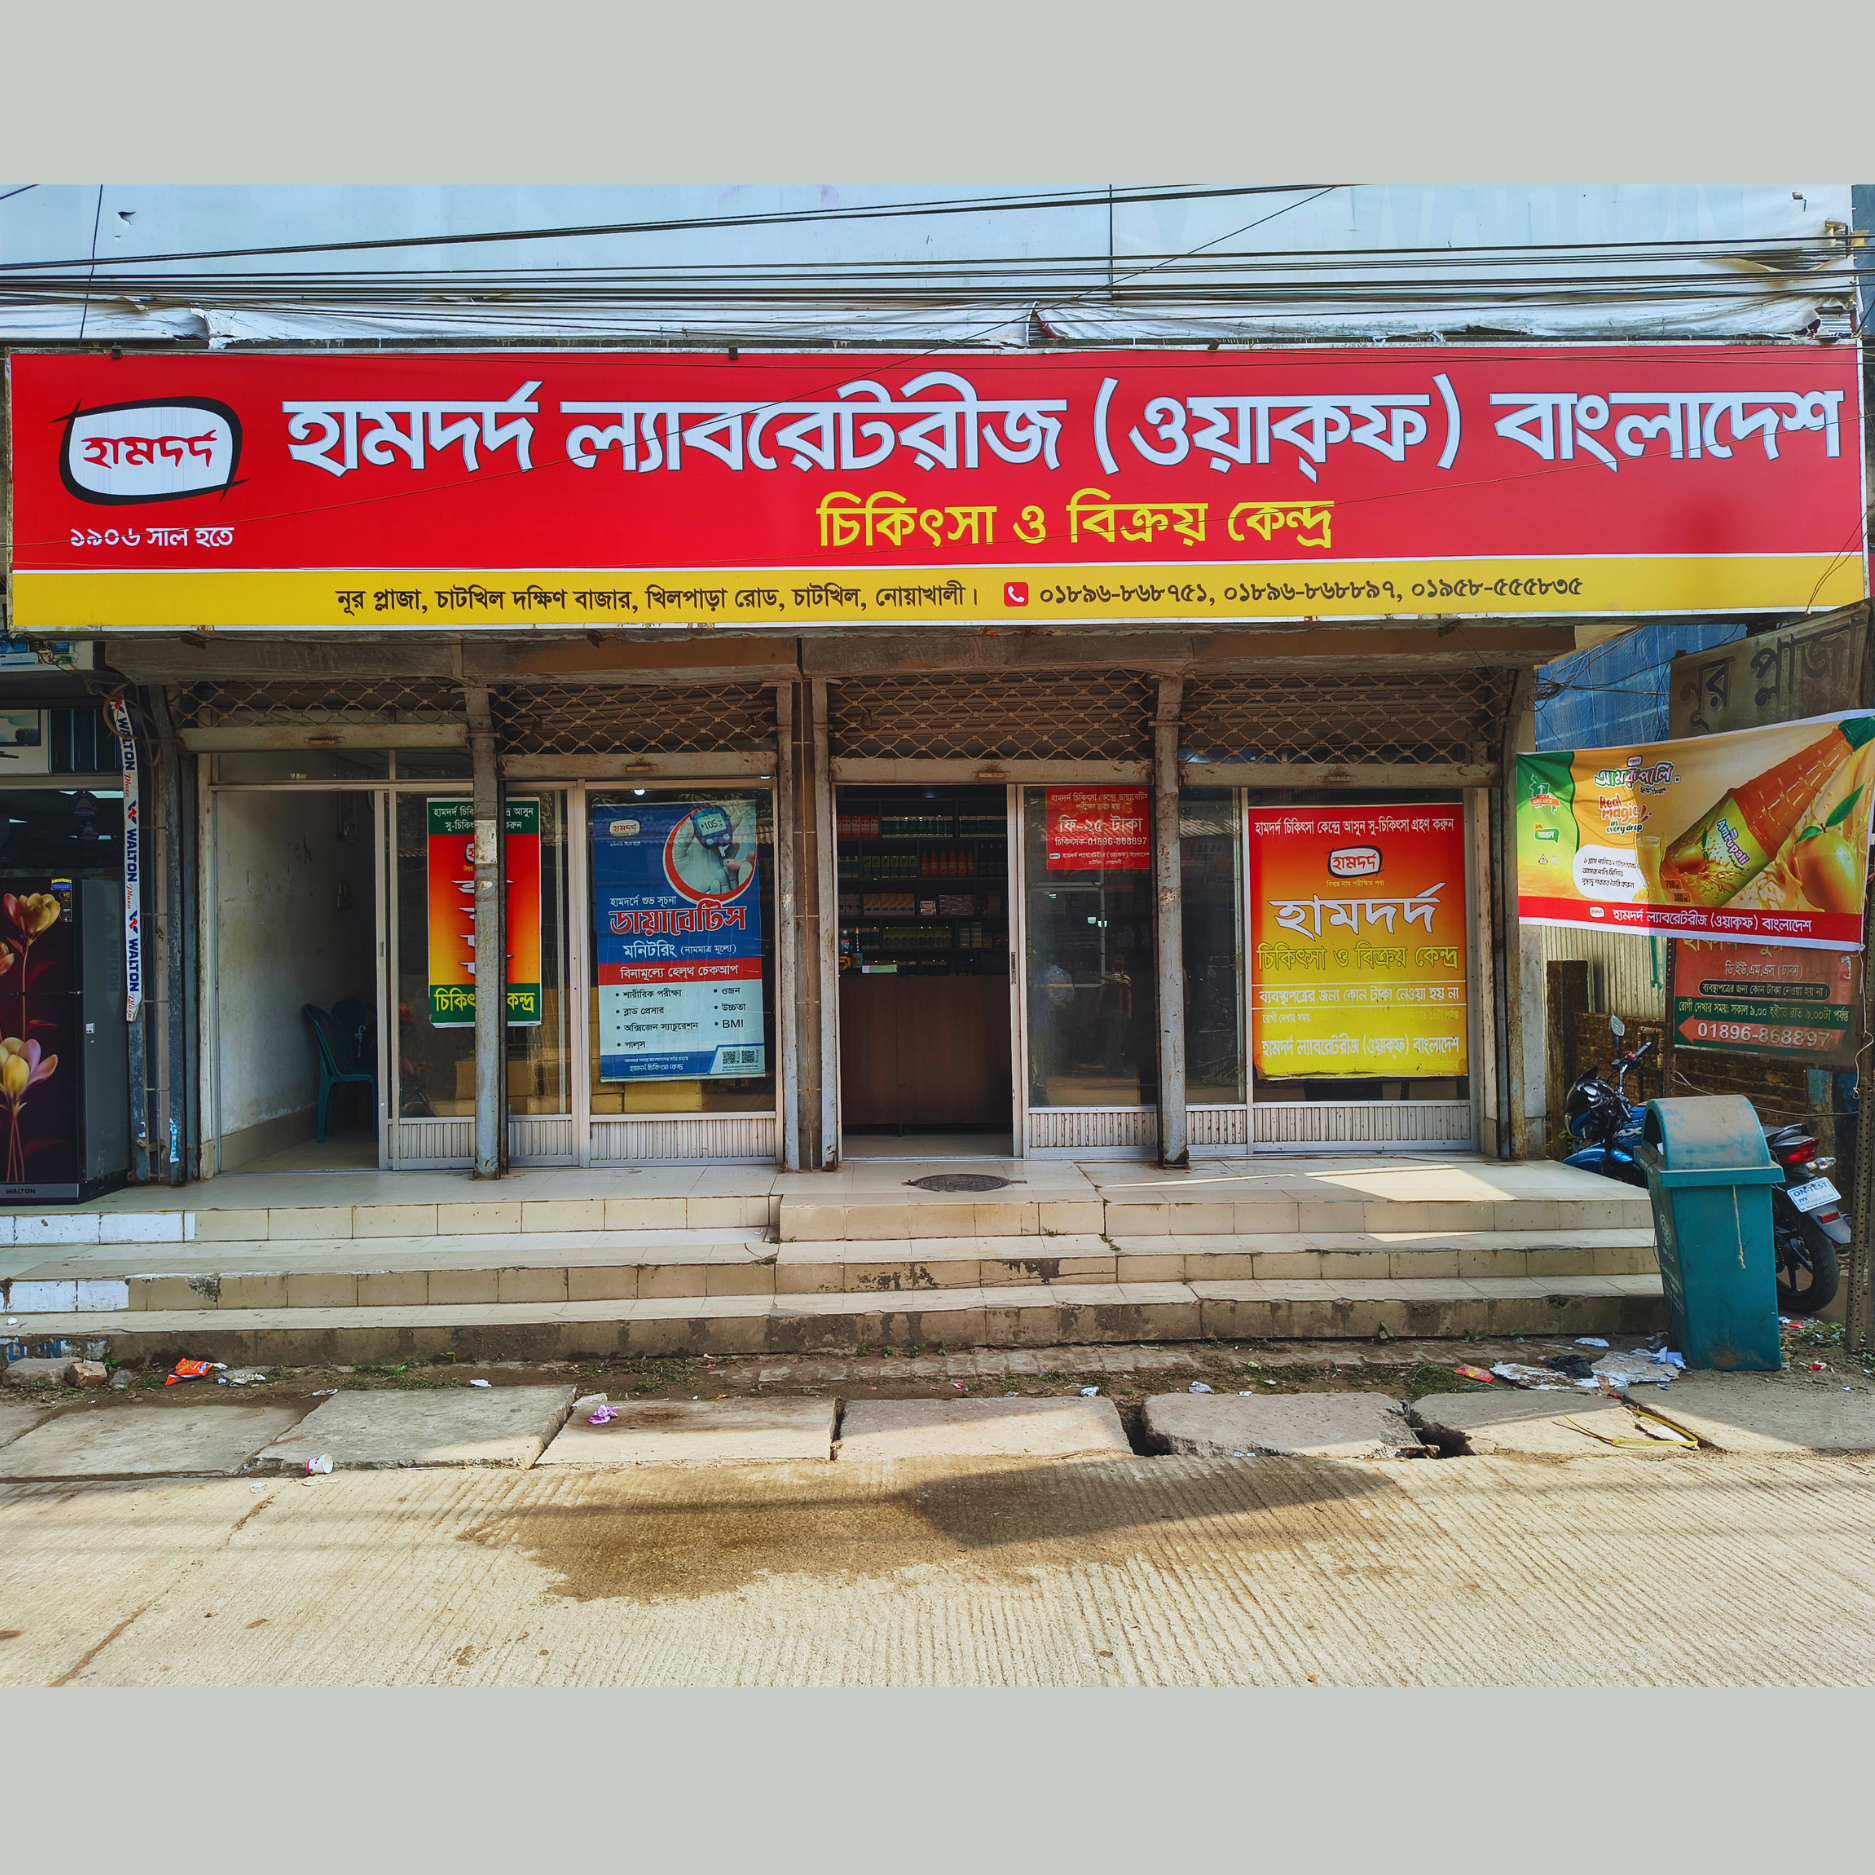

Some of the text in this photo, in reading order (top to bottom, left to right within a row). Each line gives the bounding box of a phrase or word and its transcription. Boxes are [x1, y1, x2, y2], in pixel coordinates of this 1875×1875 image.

[282, 381, 543, 478] হামদর্দ
[560, 371, 1067, 473] ল্যাবরেটরীজ
[1490, 390, 1844, 473] বাংলাদেশ
[81, 429, 218, 470] হামদর্দ
[816, 488, 1335, 548] চিকিৎসা ও বিক্রয় কেন্দ্র
[70, 526, 234, 549] ১৯০৬ সাল হতে
[335, 590, 366, 616] নূর
[373, 588, 428, 614] প্লাজা,
[434, 584, 506, 610] চাটখিল
[511, 585, 568, 610] দক্ষিণ
[572, 589, 638, 613] বাজার,
[645, 584, 728, 612] খিলপাড়া
[735, 587, 785, 612] রোড,
[791, 582, 866, 612] চাটখিল,
[1040, 584, 1215, 606] ০১৮৯৬-৮৬৮৭৫১,
[1224, 580, 1403, 602] ০১৮৯৬-৮৬৮৮৯৭,
[1412, 577, 1583, 597] ০১৯৫৮-৫৫৫৮৩৫
[118, 716, 136, 771] WALTON
[433, 806, 458, 817] হামদর্দ
[513, 807, 533, 818] আসুন
[1599, 795, 1621, 809] Real
[1110, 814, 1143, 832] টাকা
[1601, 803, 1640, 823] magic
[1255, 816, 1454, 836] হামদর্দ চিকিৎসা কেন্দ্রে আসুন সু-চিকিৎসা গ্রহণ করুন
[1626, 823, 1643, 833] drop
[1717, 818, 1751, 866] Amrupali
[126, 828, 137, 882] WALTON
[1332, 853, 1377, 871] হামদর্দ
[610, 895, 639, 907] হামদর্দে
[657, 895, 677, 908] সূচনা
[609, 898, 747, 936] ডায়াবেটিস
[1267, 882, 1447, 942] হামদর্দ
[1612, 908, 1644, 922] হামদর্দ
[1646, 909, 1708, 927] ল্যাবরেটরীজ
[1761, 917, 1812, 933] বাংলাদেশ
[622, 939, 677, 958] মনিটরিং
[1256, 939, 1459, 971] চিকিৎসা ও বিক্রয় কেন্দ্র
[128, 938, 139, 992] WALTON
[620, 966, 665, 981] বিনামূল্যে
[698, 964, 739, 976] চেকআপ
[1777, 963, 1803, 981] (ঢাকা)
[623, 988, 682, 999] শারীরিক পরীক্ষা
[721, 987, 741, 995] ওজন
[1259, 985, 1459, 1007] ব্যবস্থাপত্রের জন্য কোন টাকা নেওয়া হয় না
[1736, 984, 1748, 993] জন্য
[1750, 984, 1765, 994] কোন
[1766, 984, 1781, 996] টাকা
[641, 1006, 664, 1015] প্রেসার
[1731, 1004, 1748, 1015] সকাল
[722, 1019, 744, 1029] BMI
[1261, 1036, 1293, 1057] হামদর্দ
[1297, 1032, 1359, 1056] ল্যাবরেটরীজ
[1413, 1036, 1459, 1056] বাংলাদেশ
[1697, 1022, 1831, 1048] 01896-868897
[5, 1187, 36, 1195] WALTON
[1793, 1182, 1827, 1197] ON-TEST
